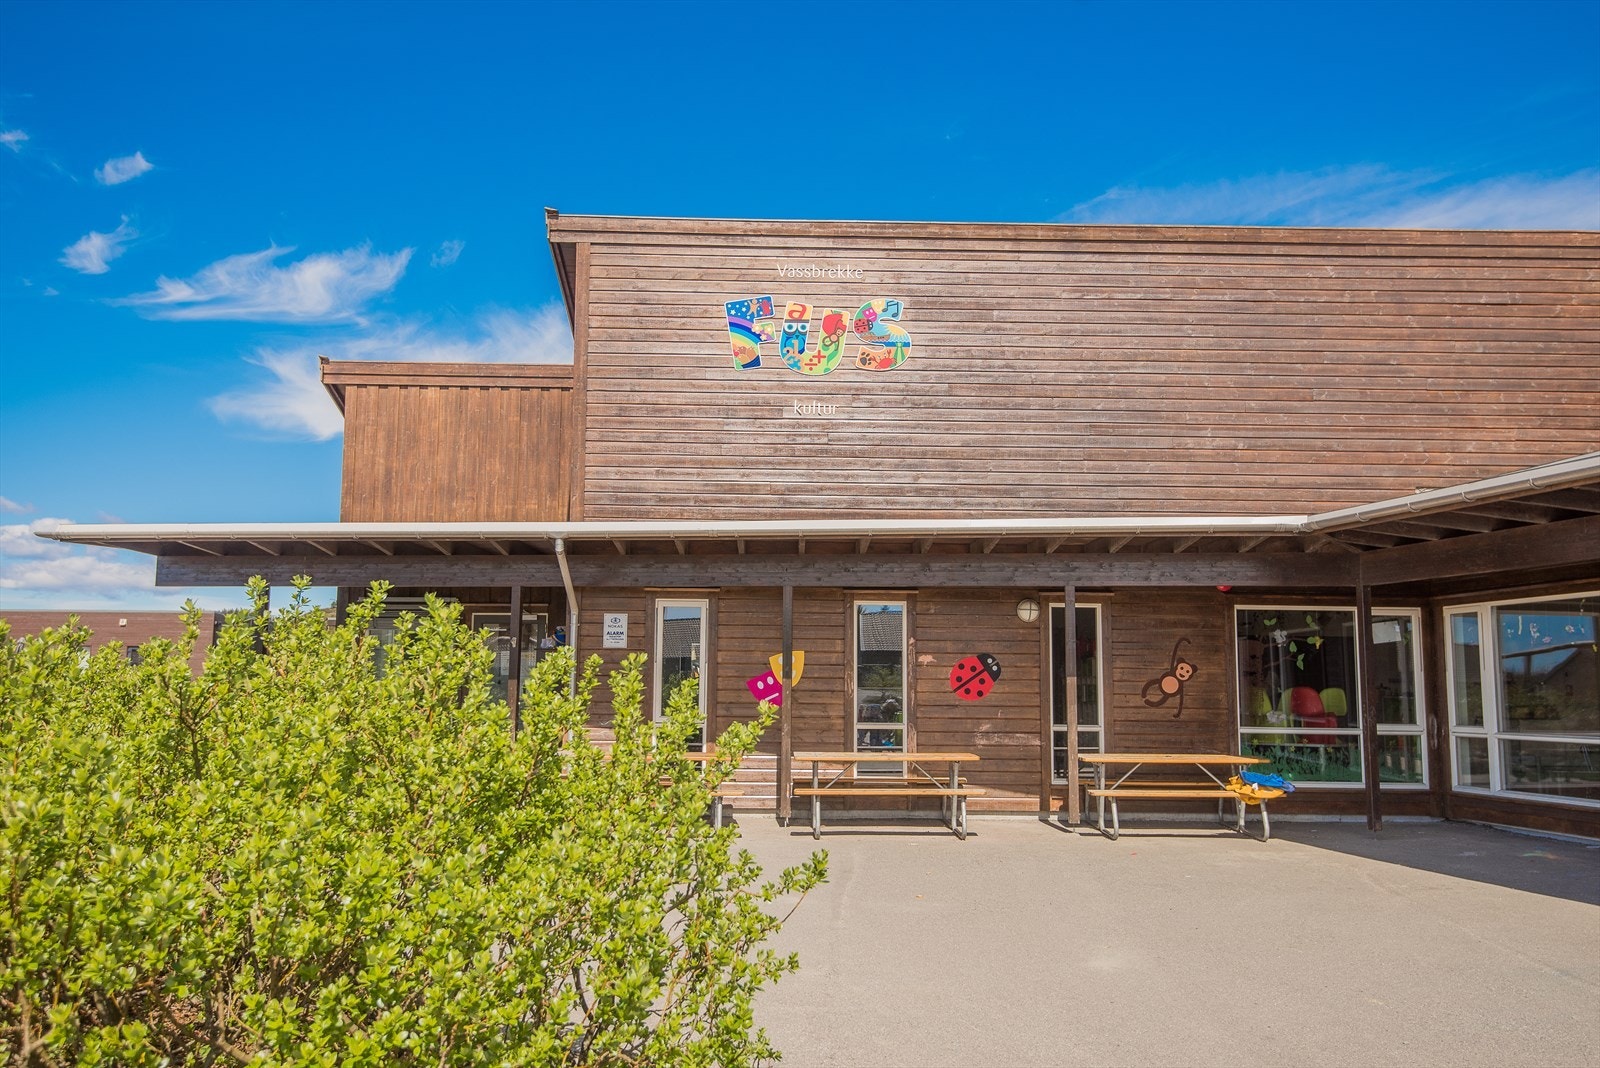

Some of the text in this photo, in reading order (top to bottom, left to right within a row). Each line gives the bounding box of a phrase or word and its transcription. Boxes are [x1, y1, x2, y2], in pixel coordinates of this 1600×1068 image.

[776, 263, 865, 280] Vassbrekke
[724, 295, 912, 376] FUS
[793, 399, 839, 416] kultur
